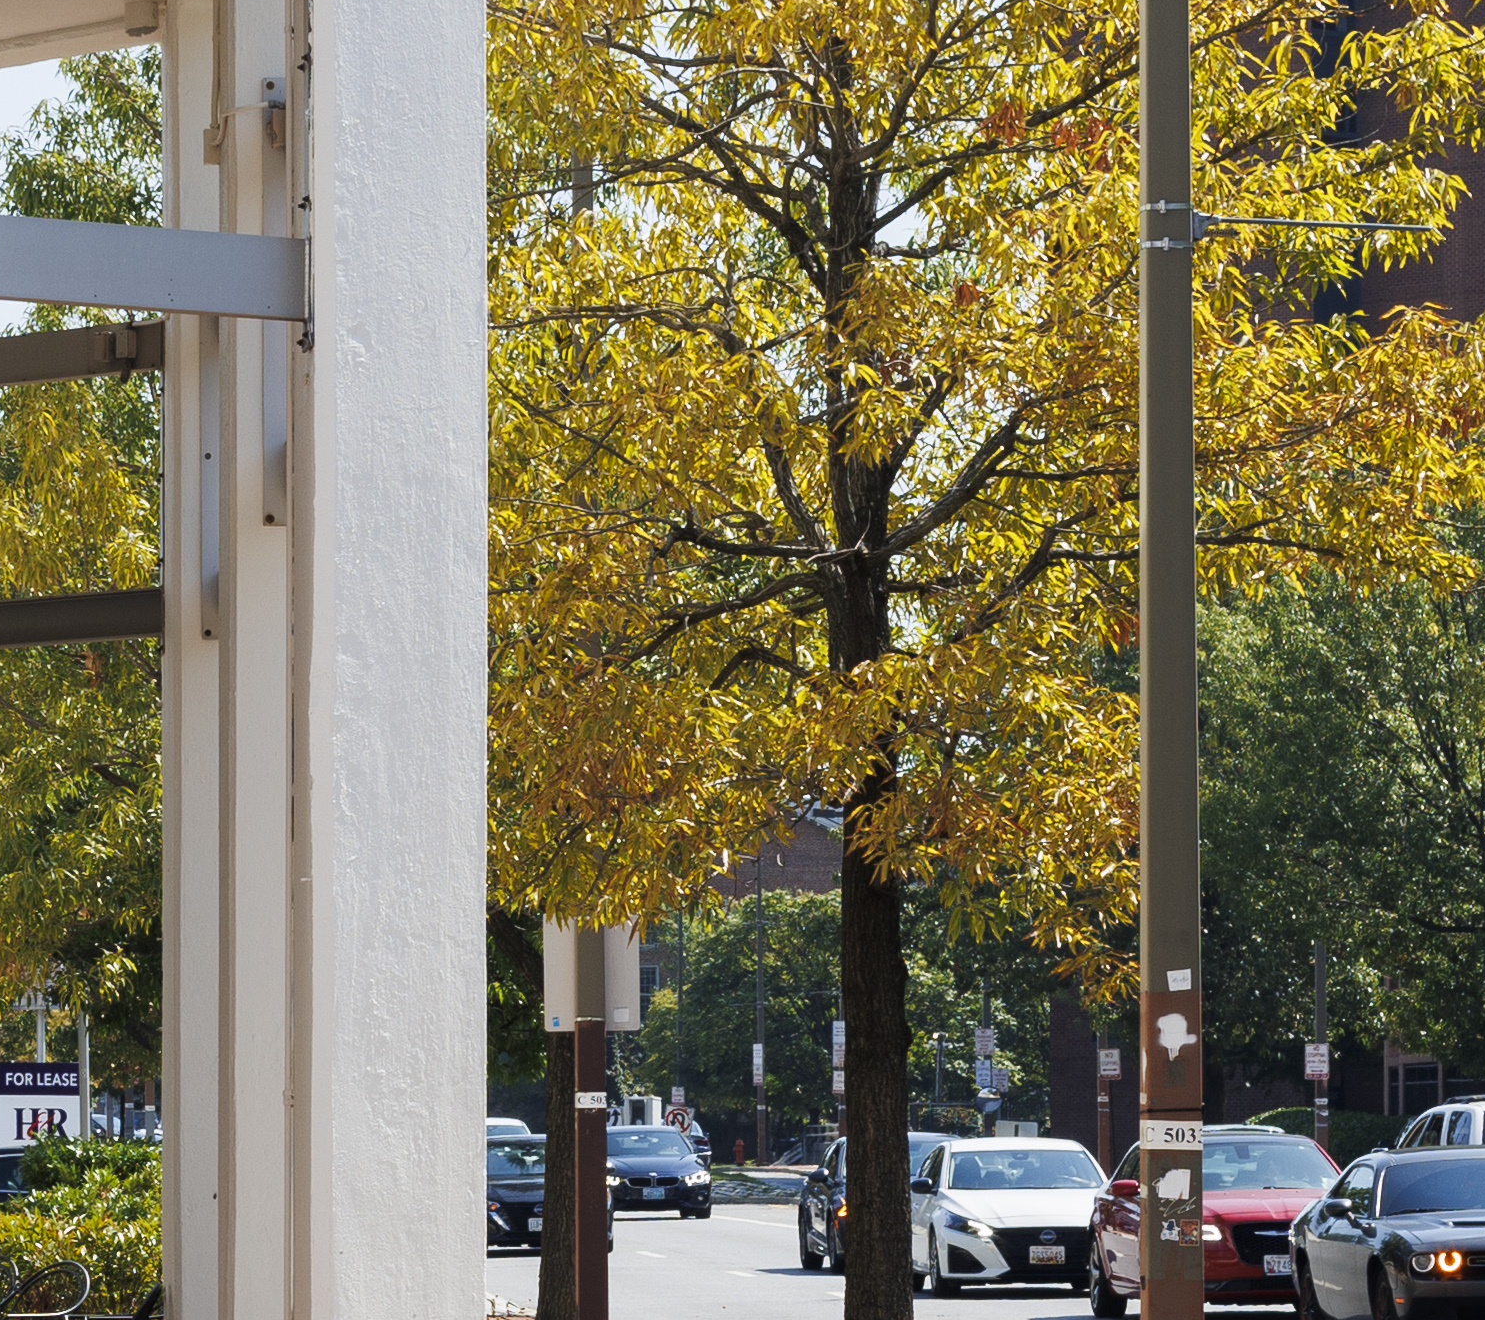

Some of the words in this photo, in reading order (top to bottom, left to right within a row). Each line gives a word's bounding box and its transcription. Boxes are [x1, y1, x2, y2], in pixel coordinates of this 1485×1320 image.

[5, 1072, 33, 1086] FOR
[36, 1072, 78, 1087] LEASE
[577, 1096, 586, 1104] C
